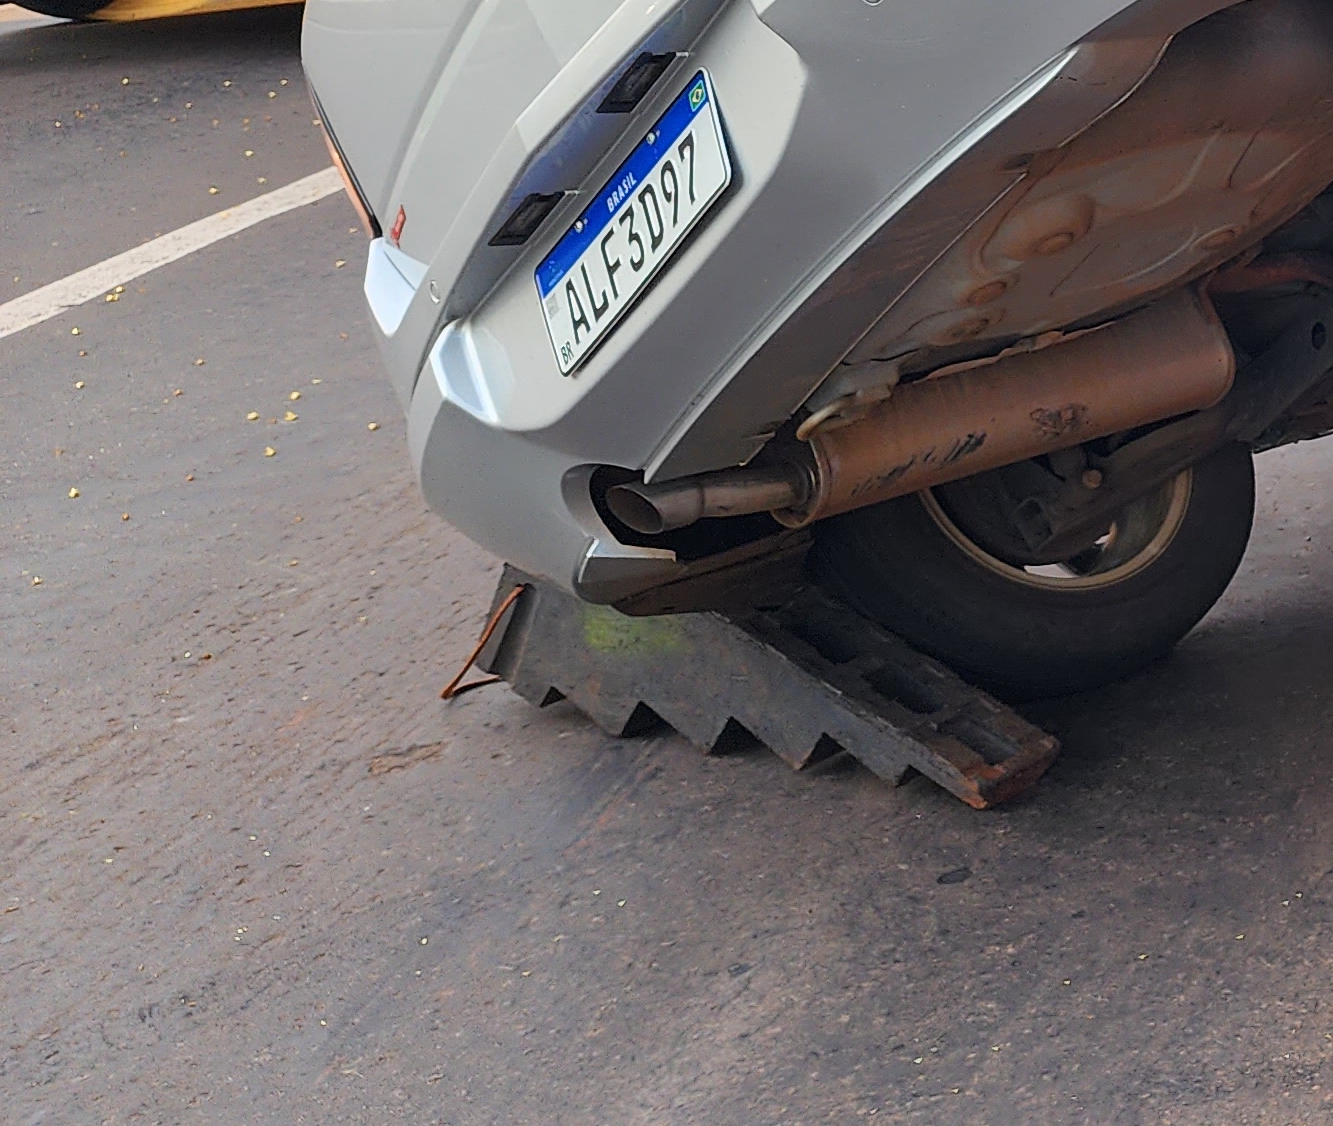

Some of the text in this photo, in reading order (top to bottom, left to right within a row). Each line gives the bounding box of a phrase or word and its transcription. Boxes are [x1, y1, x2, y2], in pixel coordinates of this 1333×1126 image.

[606, 171, 638, 213] BRASIL
[565, 129, 697, 345] ALF3D97
[561, 340, 575, 366] BR
